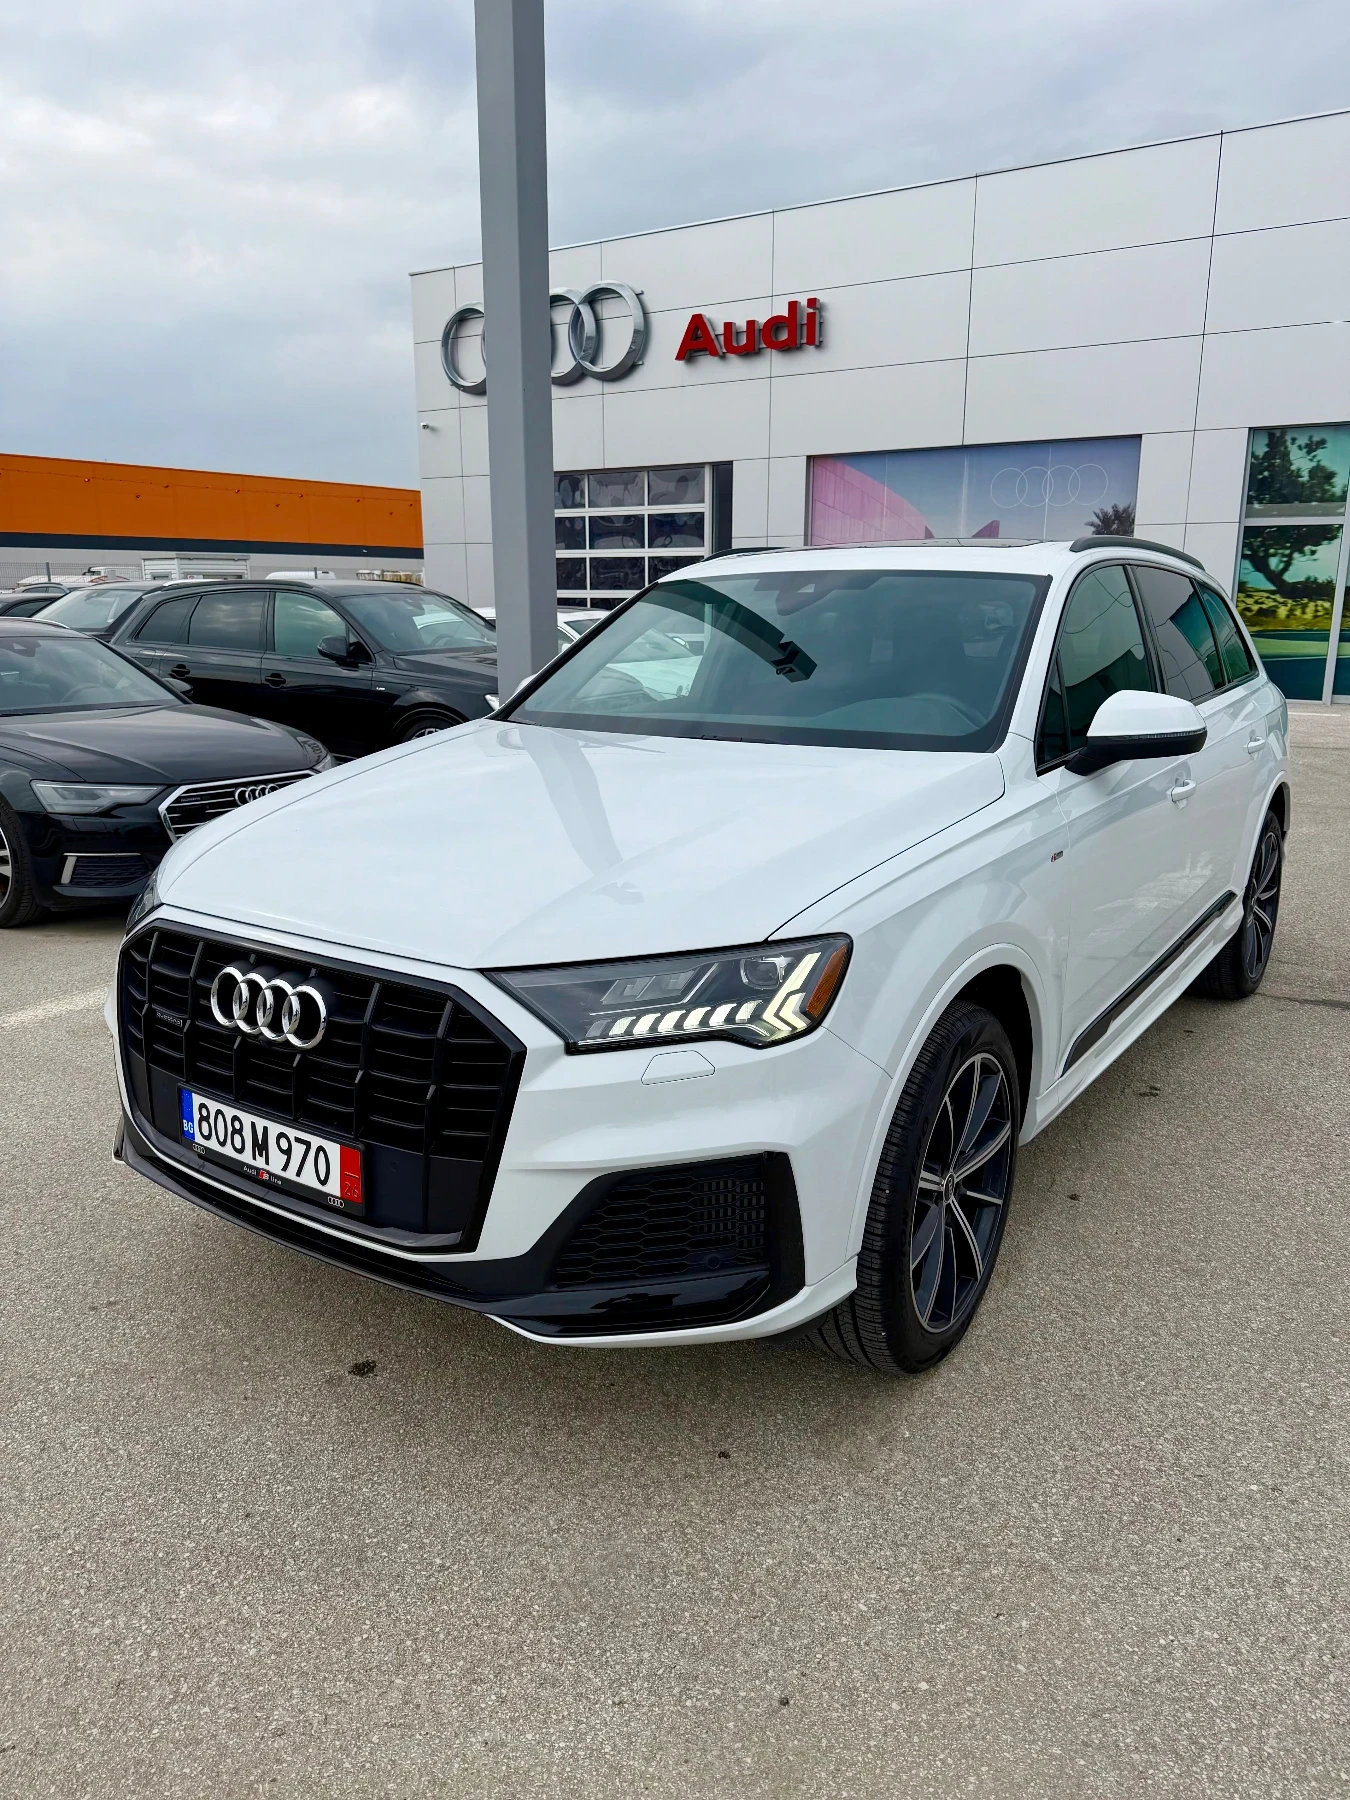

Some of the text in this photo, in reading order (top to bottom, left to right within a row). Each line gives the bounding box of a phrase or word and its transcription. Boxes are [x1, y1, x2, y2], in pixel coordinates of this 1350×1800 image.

[675, 297, 820, 361] Audi
[183, 1119, 194, 1134] BG
[243, 1165, 257, 1176] Audi
